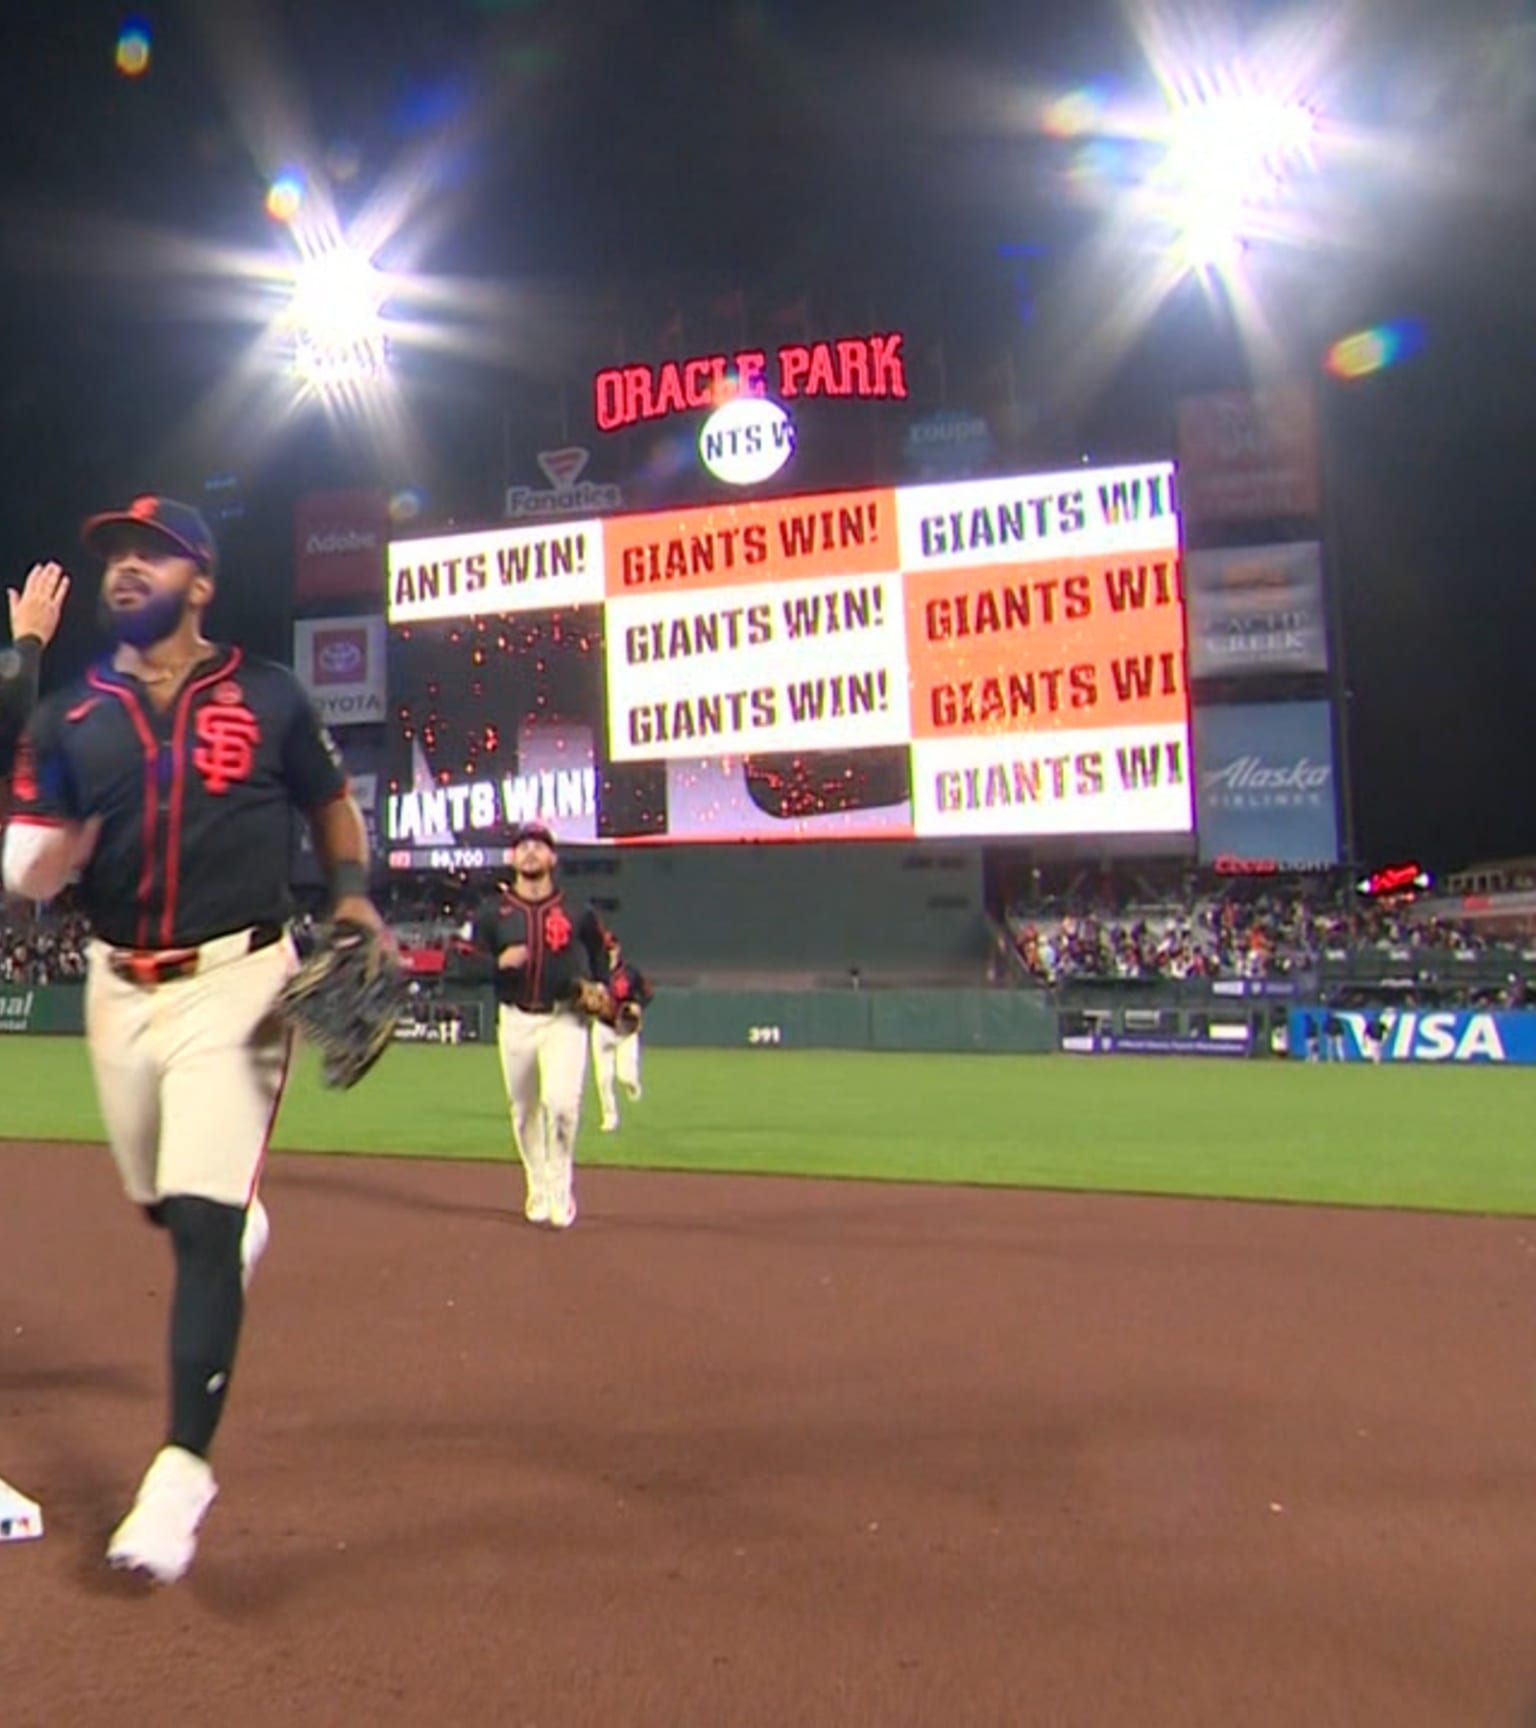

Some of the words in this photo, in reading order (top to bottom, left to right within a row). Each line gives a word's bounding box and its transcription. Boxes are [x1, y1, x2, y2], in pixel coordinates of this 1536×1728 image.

[595, 353, 766, 431] ORACLE
[779, 333, 908, 397] PARK
[509, 483, 622, 514] Fanatics
[921, 490, 1085, 557] GIANTS
[306, 530, 377, 553] Adobe
[395, 553, 487, 606] ANTS
[496, 534, 586, 587] WIN!
[622, 525, 767, 587] GIANTS
[778, 503, 879, 558] WIN!
[625, 604, 772, 666] GIANTS
[783, 585, 884, 640] WIN!
[925, 575, 1092, 642] GIANTS
[628, 687, 776, 746] GIANTS
[787, 668, 888, 723] WIN!
[931, 663, 1098, 729] GIANTS
[503, 767, 596, 823] WIN!
[935, 752, 1104, 813] GIANTS
[1202, 756, 1332, 790] Alaska
[1335, 1011, 1506, 1060] VISA
